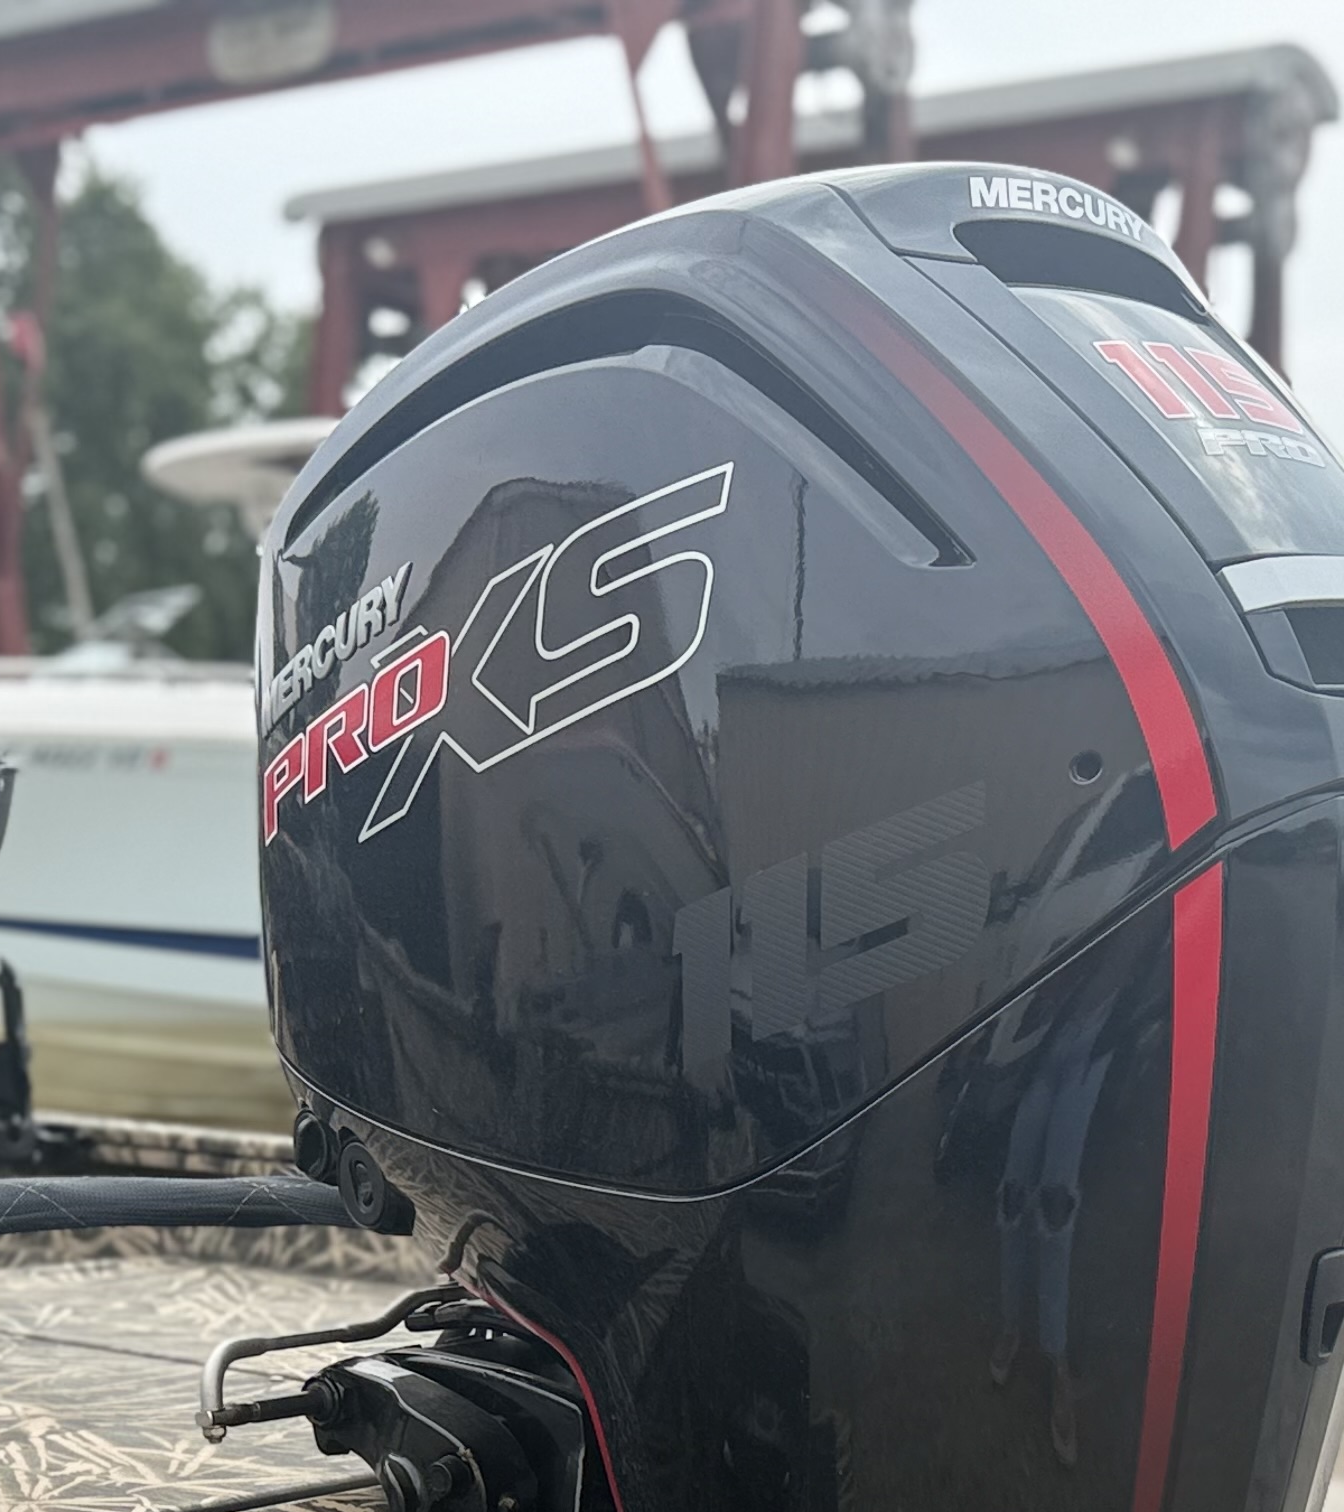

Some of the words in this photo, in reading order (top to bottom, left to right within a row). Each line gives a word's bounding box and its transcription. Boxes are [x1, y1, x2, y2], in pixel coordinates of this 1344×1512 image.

[968, 176, 1144, 241] MERCURY
[1093, 341, 1304, 434] 115
[1197, 428, 1326, 467] PRO
[264, 630, 451, 847] PRO
